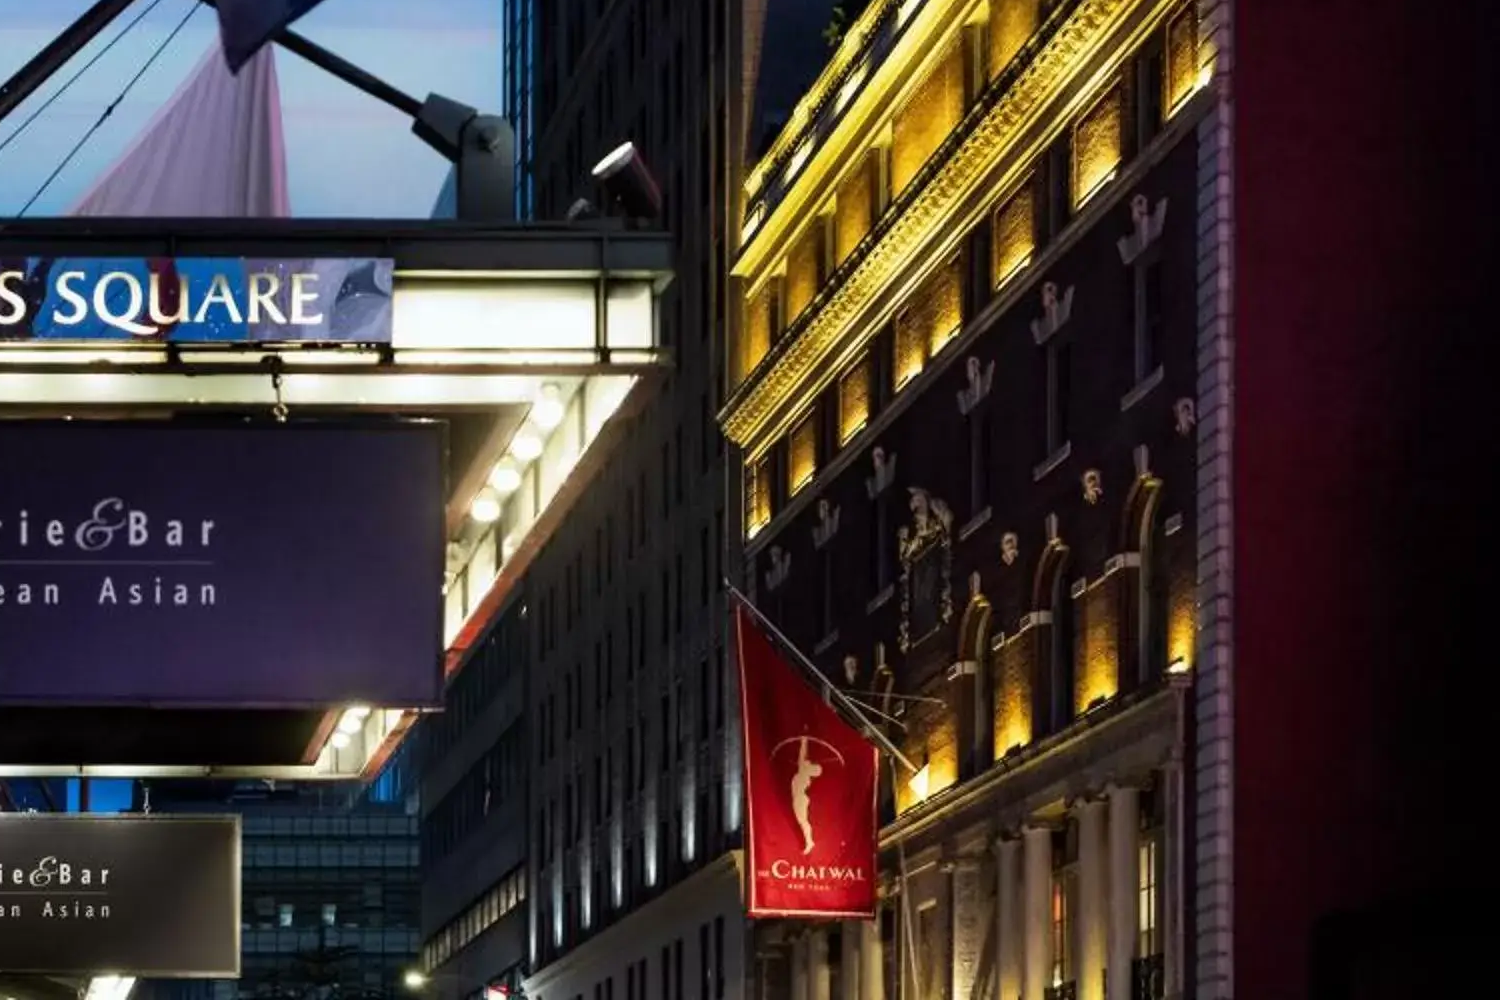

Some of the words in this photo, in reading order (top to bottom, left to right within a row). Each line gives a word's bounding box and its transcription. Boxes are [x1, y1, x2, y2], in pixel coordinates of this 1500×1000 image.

[52, 270, 324, 336] SQUARE
[98, 575, 216, 605] Asian
[42, 901, 110, 918] Asian
